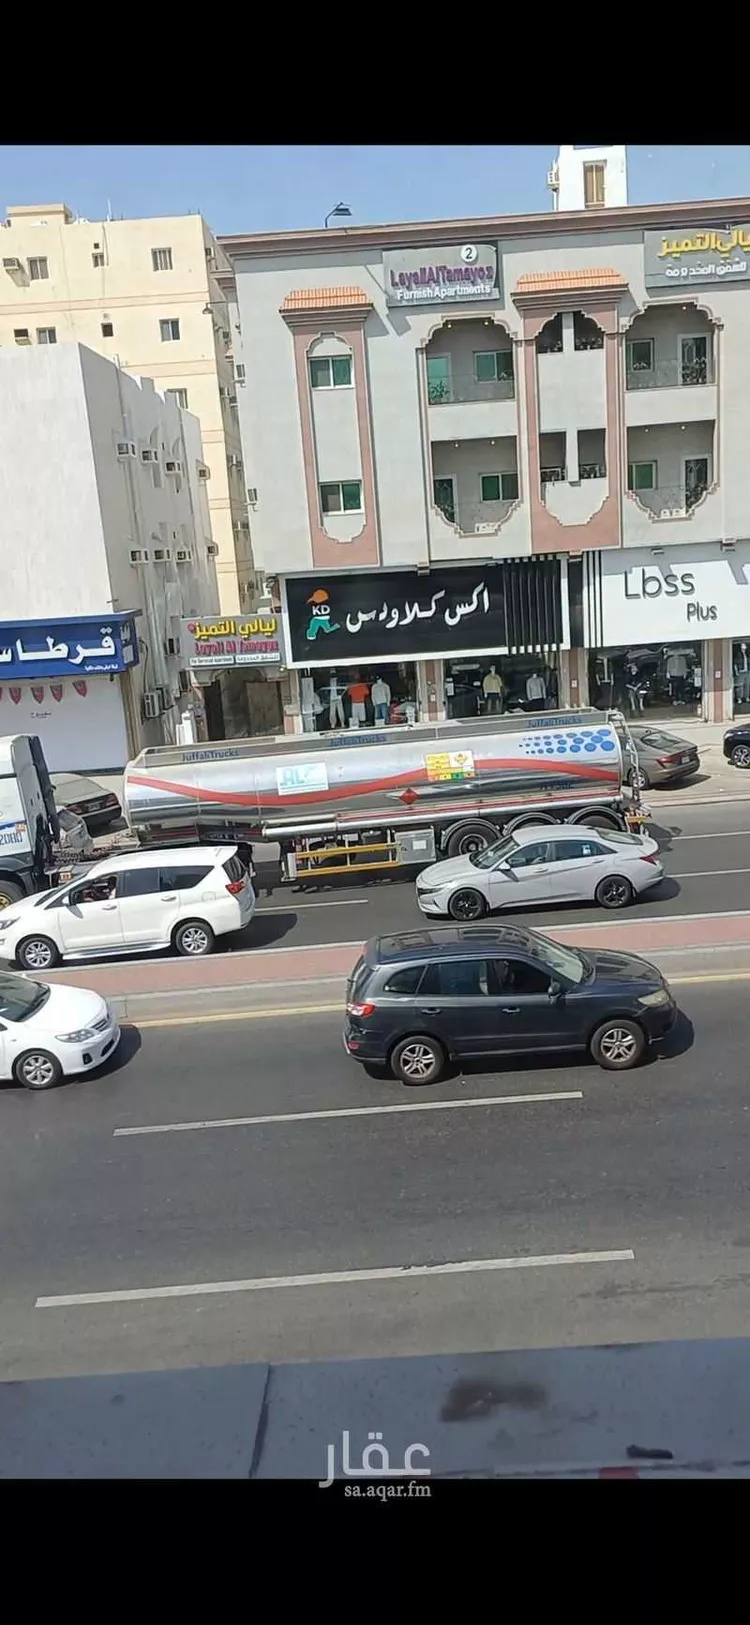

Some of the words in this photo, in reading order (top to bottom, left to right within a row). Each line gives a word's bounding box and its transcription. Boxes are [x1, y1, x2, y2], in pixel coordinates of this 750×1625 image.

[465, 247, 473, 259] 2
[657, 231, 716, 258] التميز
[624, 567, 696, 600] Lbss
[312, 604, 331, 616] KD
[346, 590, 446, 633] كلاودس
[444, 582, 489, 626] اكس
[686, 602, 718, 622] Plus
[194, 620, 235, 640] التميز
[239, 617, 277, 638] ليالي
